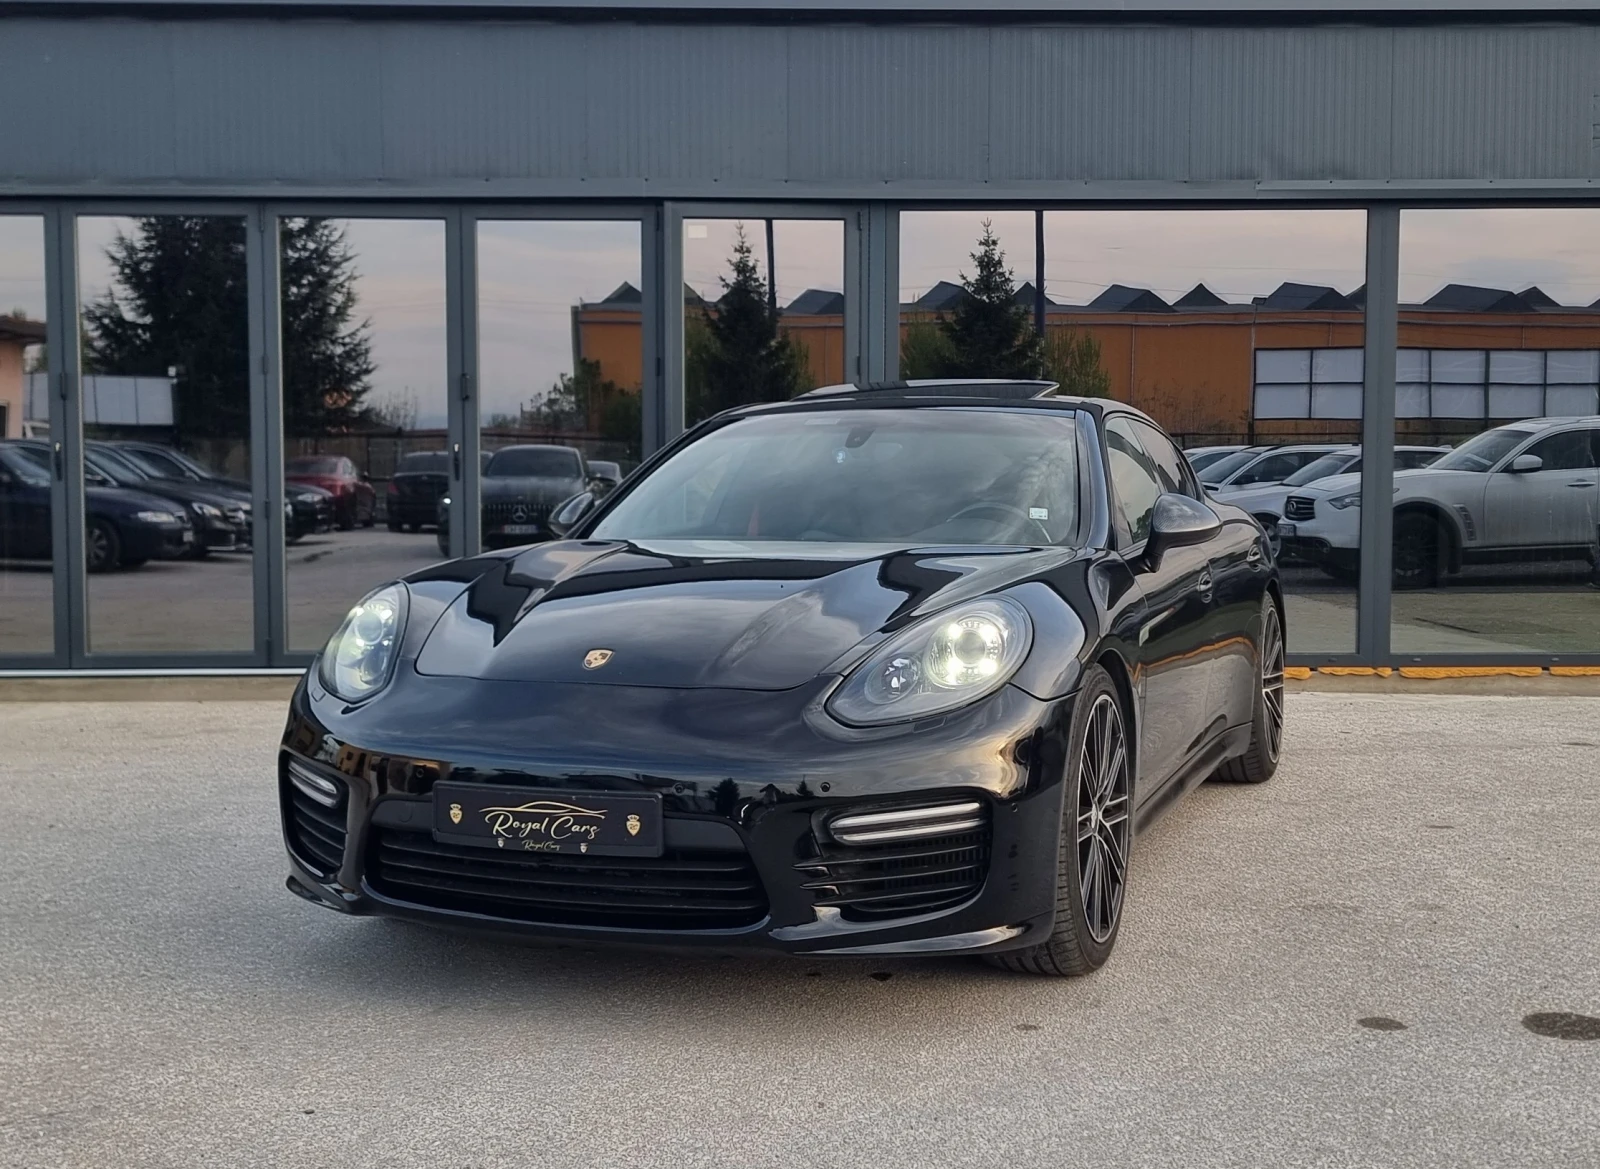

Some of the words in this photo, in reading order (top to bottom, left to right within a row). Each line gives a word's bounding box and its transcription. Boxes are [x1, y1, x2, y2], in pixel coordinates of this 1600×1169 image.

[484, 811, 549, 838] Royal
[550, 816, 600, 839] Cars
[522, 840, 544, 851] Royal
